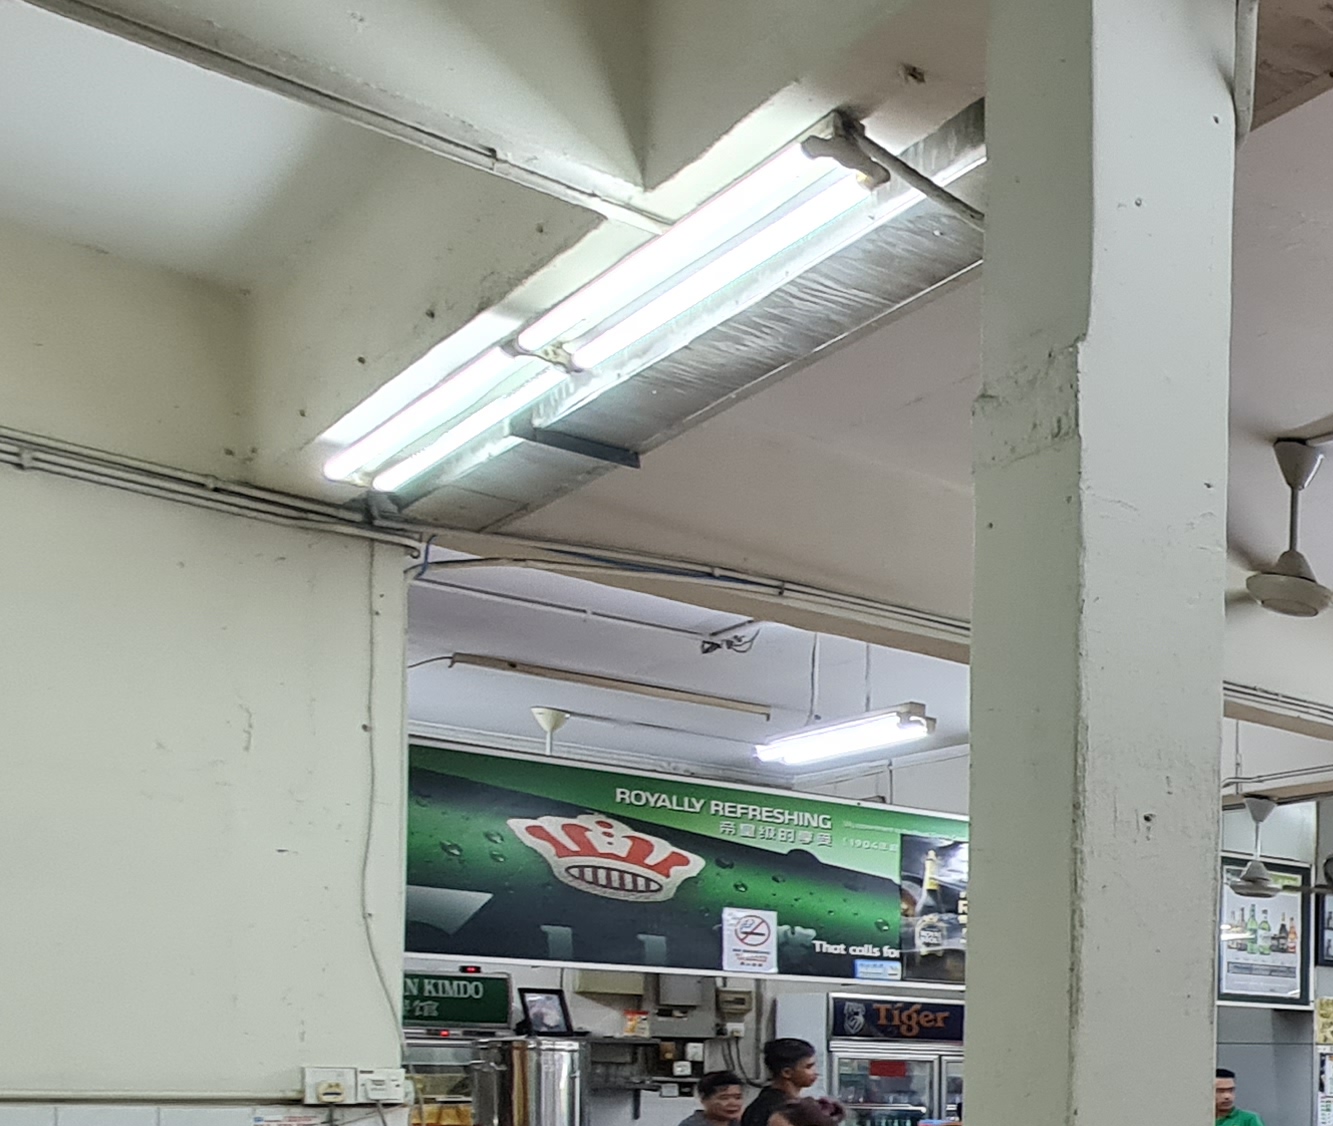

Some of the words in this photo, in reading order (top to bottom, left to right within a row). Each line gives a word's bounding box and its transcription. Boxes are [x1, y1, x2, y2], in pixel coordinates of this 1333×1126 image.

[614, 787, 705, 813] ROYALLY
[709, 800, 833, 829] REFRESHING
[811, 939, 847, 956] That
[848, 945, 880, 958] calls
[423, 978, 484, 999] KIMDO
[872, 1002, 950, 1037] Tiger
